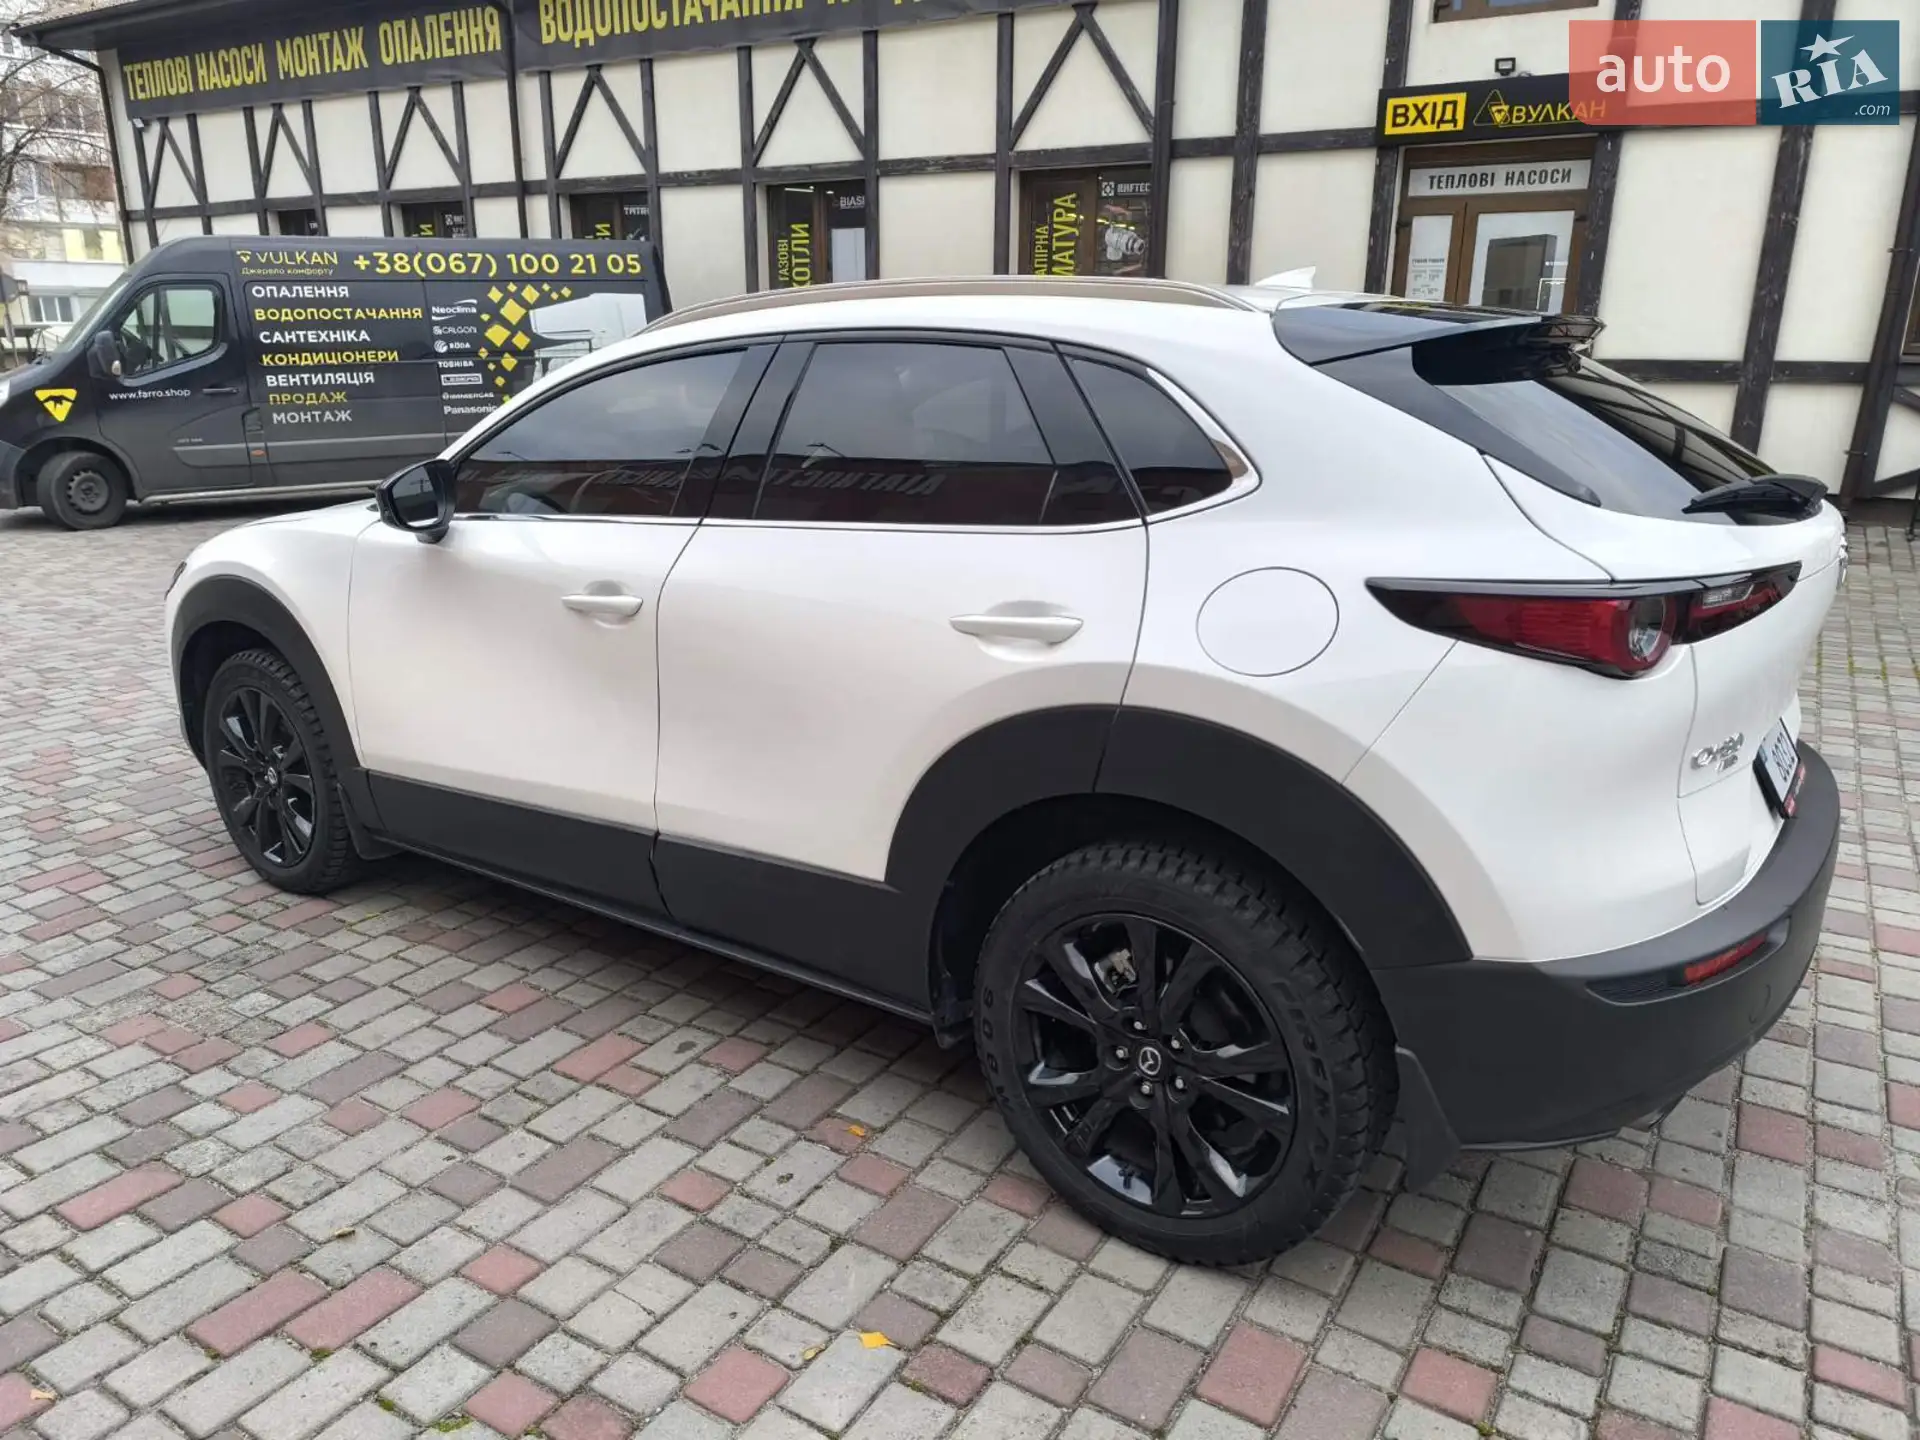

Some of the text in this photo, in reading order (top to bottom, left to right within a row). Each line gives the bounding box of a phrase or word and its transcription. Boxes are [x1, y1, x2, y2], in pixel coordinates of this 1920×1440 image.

[123, 6, 502, 101] ТЕПЛОВІ НАСОСИ МОНТАЖ ОПАЛЕННЯ
[1391, 100, 1458, 129] ВХІД
[1511, 99, 1607, 124] ВУЛКАН
[1428, 168, 1572, 190] ТЕПЛОВІ НАСОСИ
[256, 251, 642, 277] VULKAN +38(067) 100 21 05
[252, 285, 349, 298] ОПАЛЕННЯ
[254, 307, 422, 322] ВОДОПОСТАЧАННЯ
[431, 305, 477, 314] Neoclima
[259, 330, 371, 344] САНТЕХНІКА
[262, 351, 399, 366] КОНДИЦІОНЕРИ
[438, 360, 474, 368] TOSHIBA
[266, 372, 375, 388] ВЕНТИЛЯЦІЯ
[109, 388, 191, 401] www.farro.shop
[269, 392, 348, 406] ПРОДАЖ
[443, 404, 498, 415] Panasonic
[272, 410, 352, 425] МОНТАЖ
